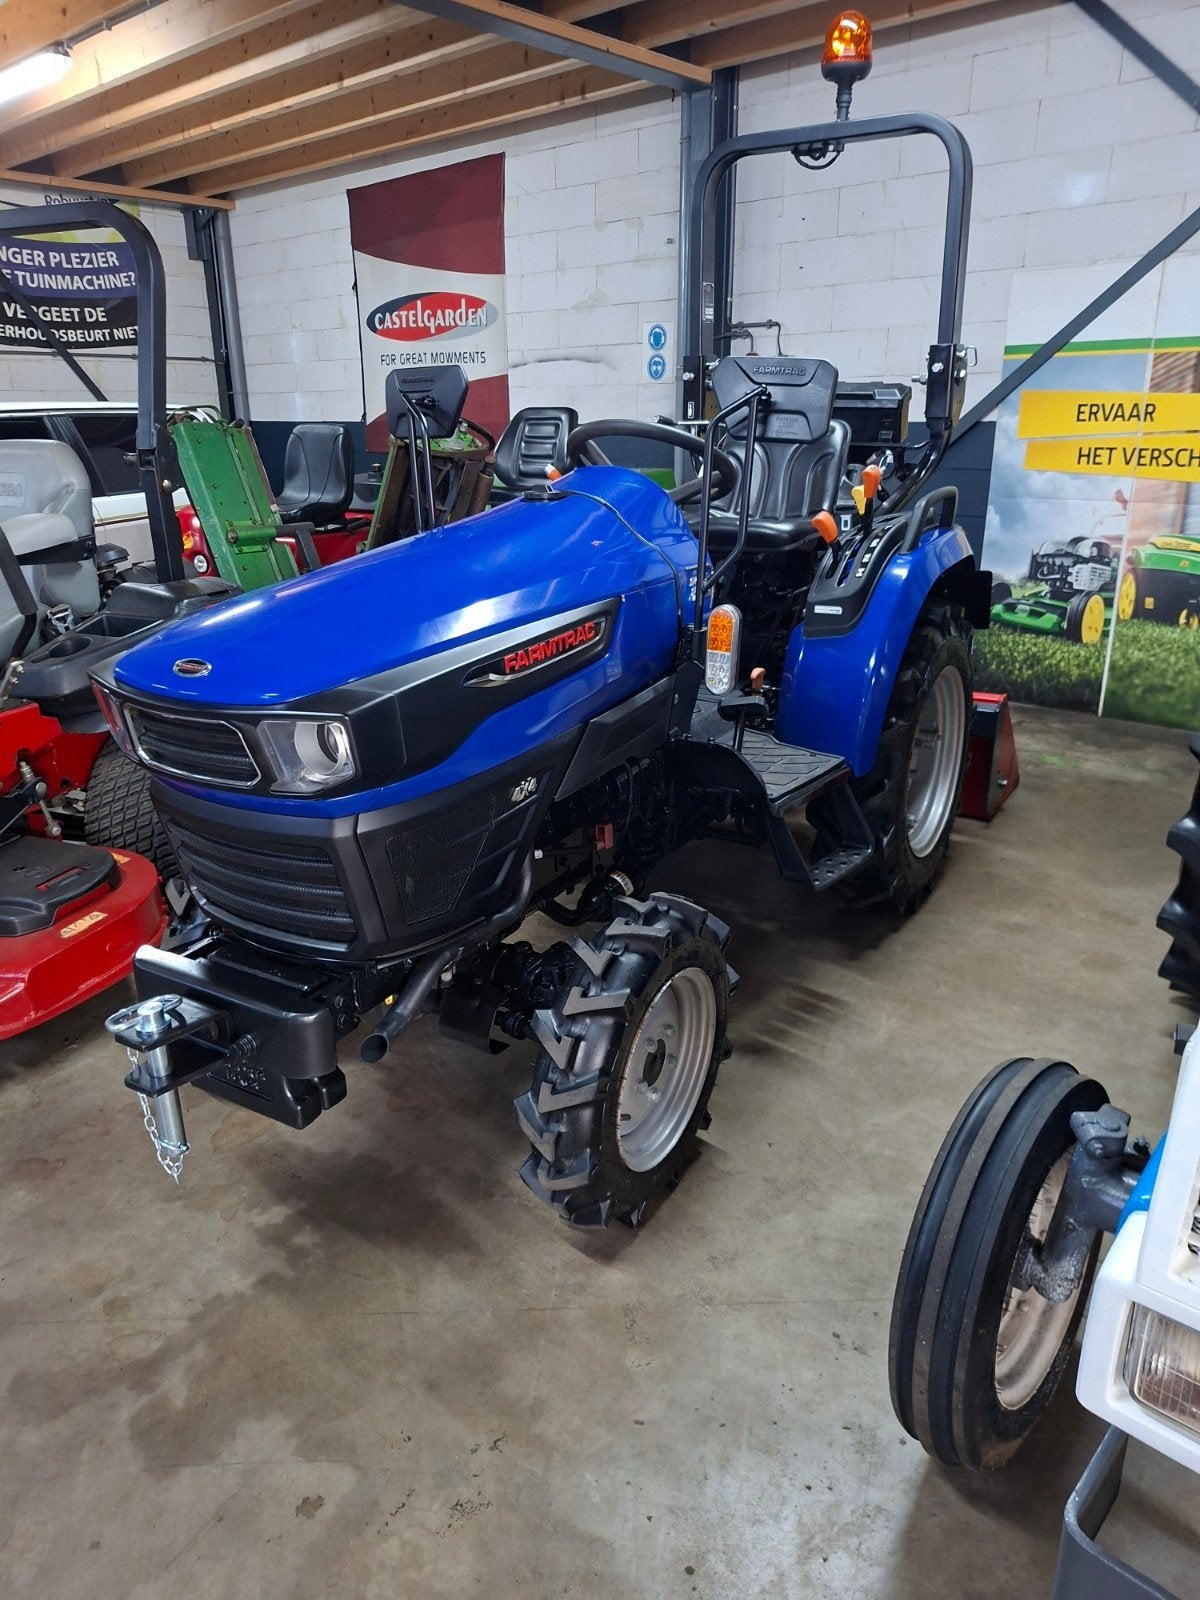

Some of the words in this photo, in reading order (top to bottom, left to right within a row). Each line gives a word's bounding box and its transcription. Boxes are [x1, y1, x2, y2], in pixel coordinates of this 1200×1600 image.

[50, 251, 119, 269] PLEZIER
[14, 271, 136, 290] TUINMACHINE?
[2, 301, 80, 322] VEGEET
[84, 307, 108, 322] DE
[380, 354, 397, 366] FOR
[400, 352, 428, 365] GREAT
[430, 351, 486, 364] MOWMENTS
[753, 366, 808, 377] FARMTRAC
[1076, 403, 1156, 422] ERVAAR
[1077, 447, 1117, 466] HET
[1122, 447, 1200, 468] VERSCH
[504, 621, 596, 674] FARMTRAC
